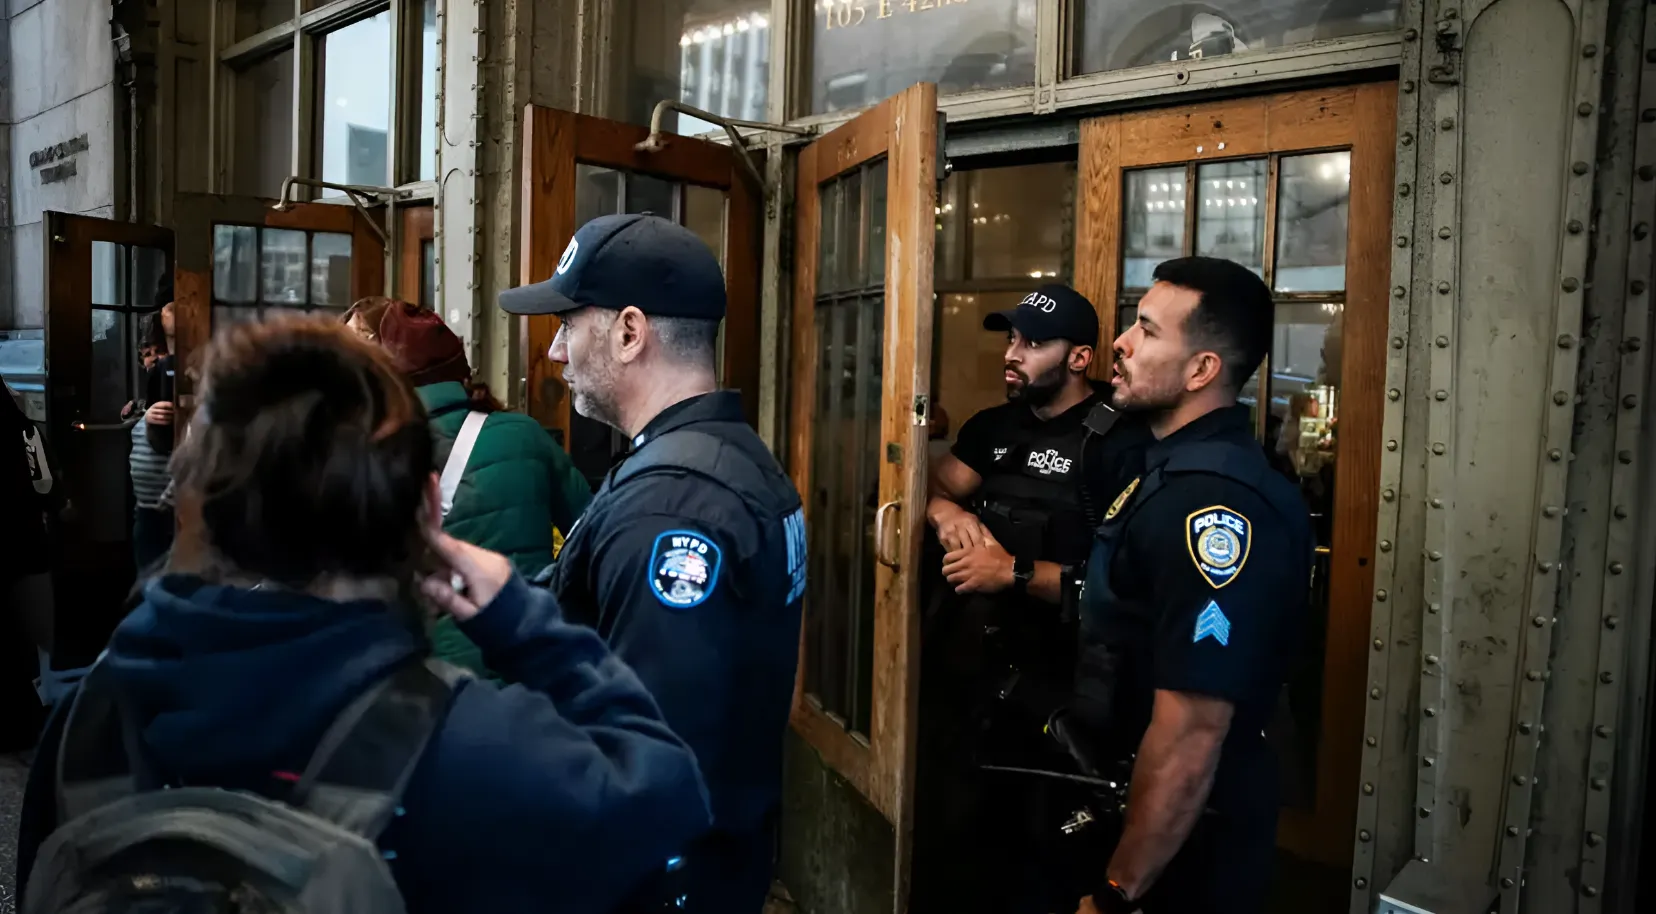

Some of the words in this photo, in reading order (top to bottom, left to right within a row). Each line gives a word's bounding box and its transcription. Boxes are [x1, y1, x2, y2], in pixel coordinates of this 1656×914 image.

[825, 1, 865, 30] 105
[876, 0, 894, 19] E
[1194, 513, 1245, 536] POLICE
